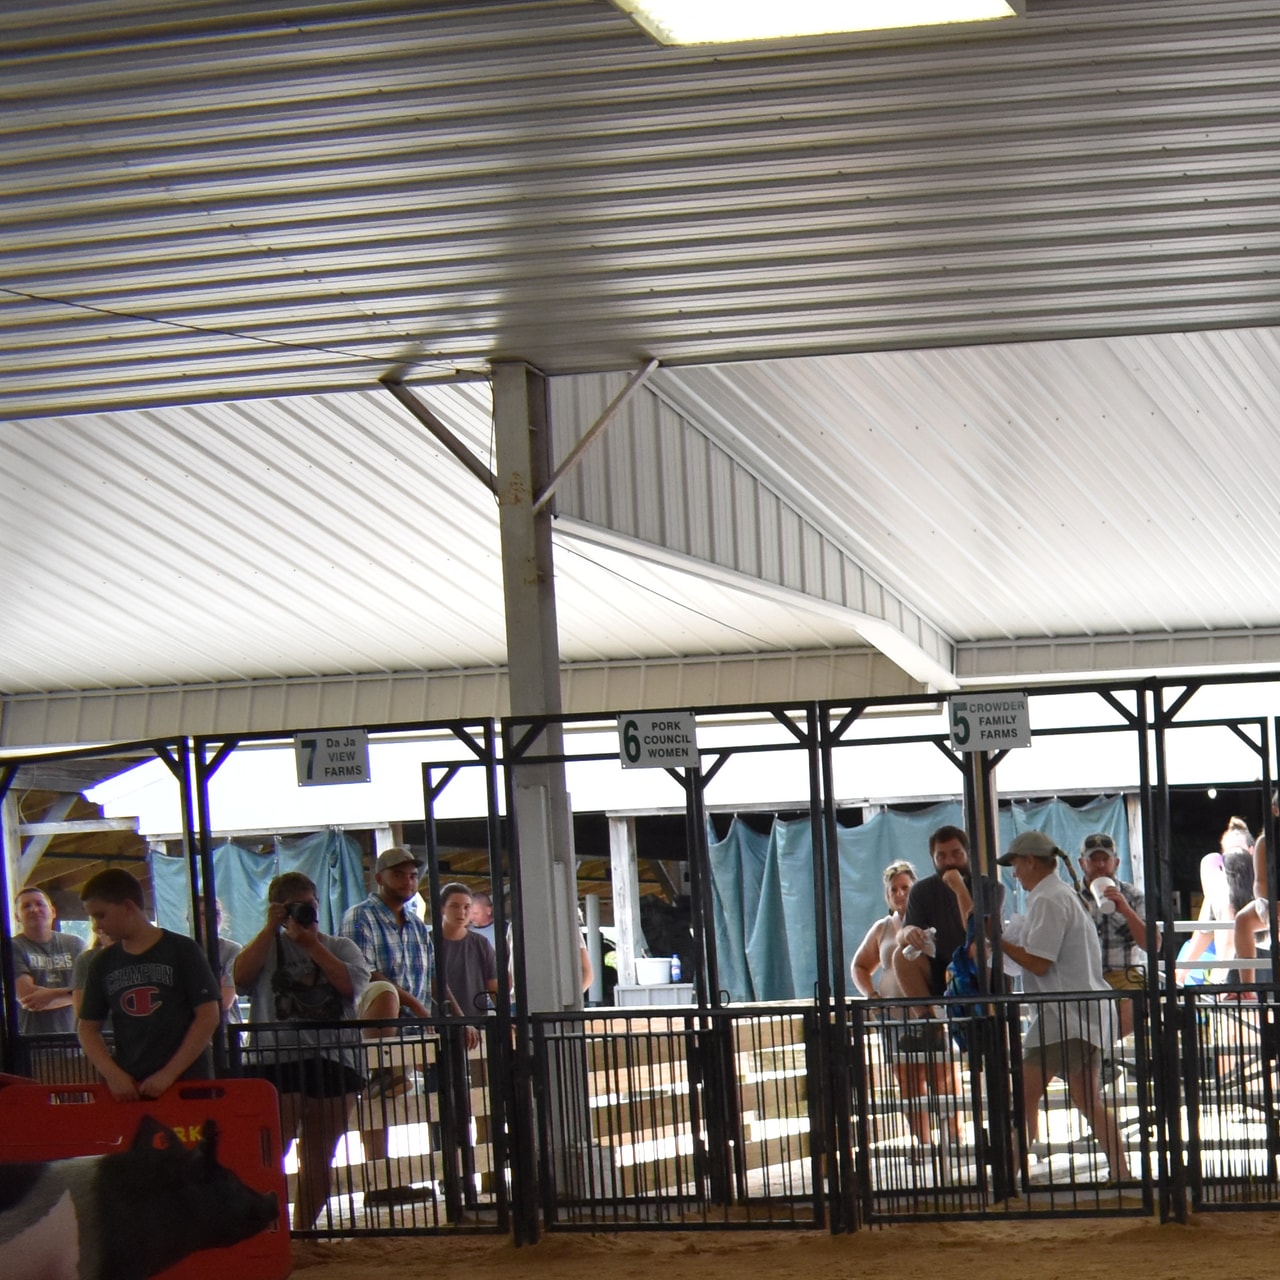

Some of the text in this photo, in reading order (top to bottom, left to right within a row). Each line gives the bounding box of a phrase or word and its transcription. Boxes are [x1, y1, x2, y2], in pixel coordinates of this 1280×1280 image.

[969, 701, 1025, 713] CROWDER
[953, 702, 970, 746] 5
[979, 715, 1017, 726] FAMILY
[652, 722, 681, 731] PORK
[981, 728, 1018, 740] FARMS
[327, 737, 356, 748] Da Ja
[623, 719, 641, 763] 6
[644, 735, 691, 745] COUNCIL
[328, 751, 356, 762] VIEW
[648, 748, 688, 758] WOMEN
[301, 739, 317, 780] 7
[325, 765, 362, 777] FARMS
